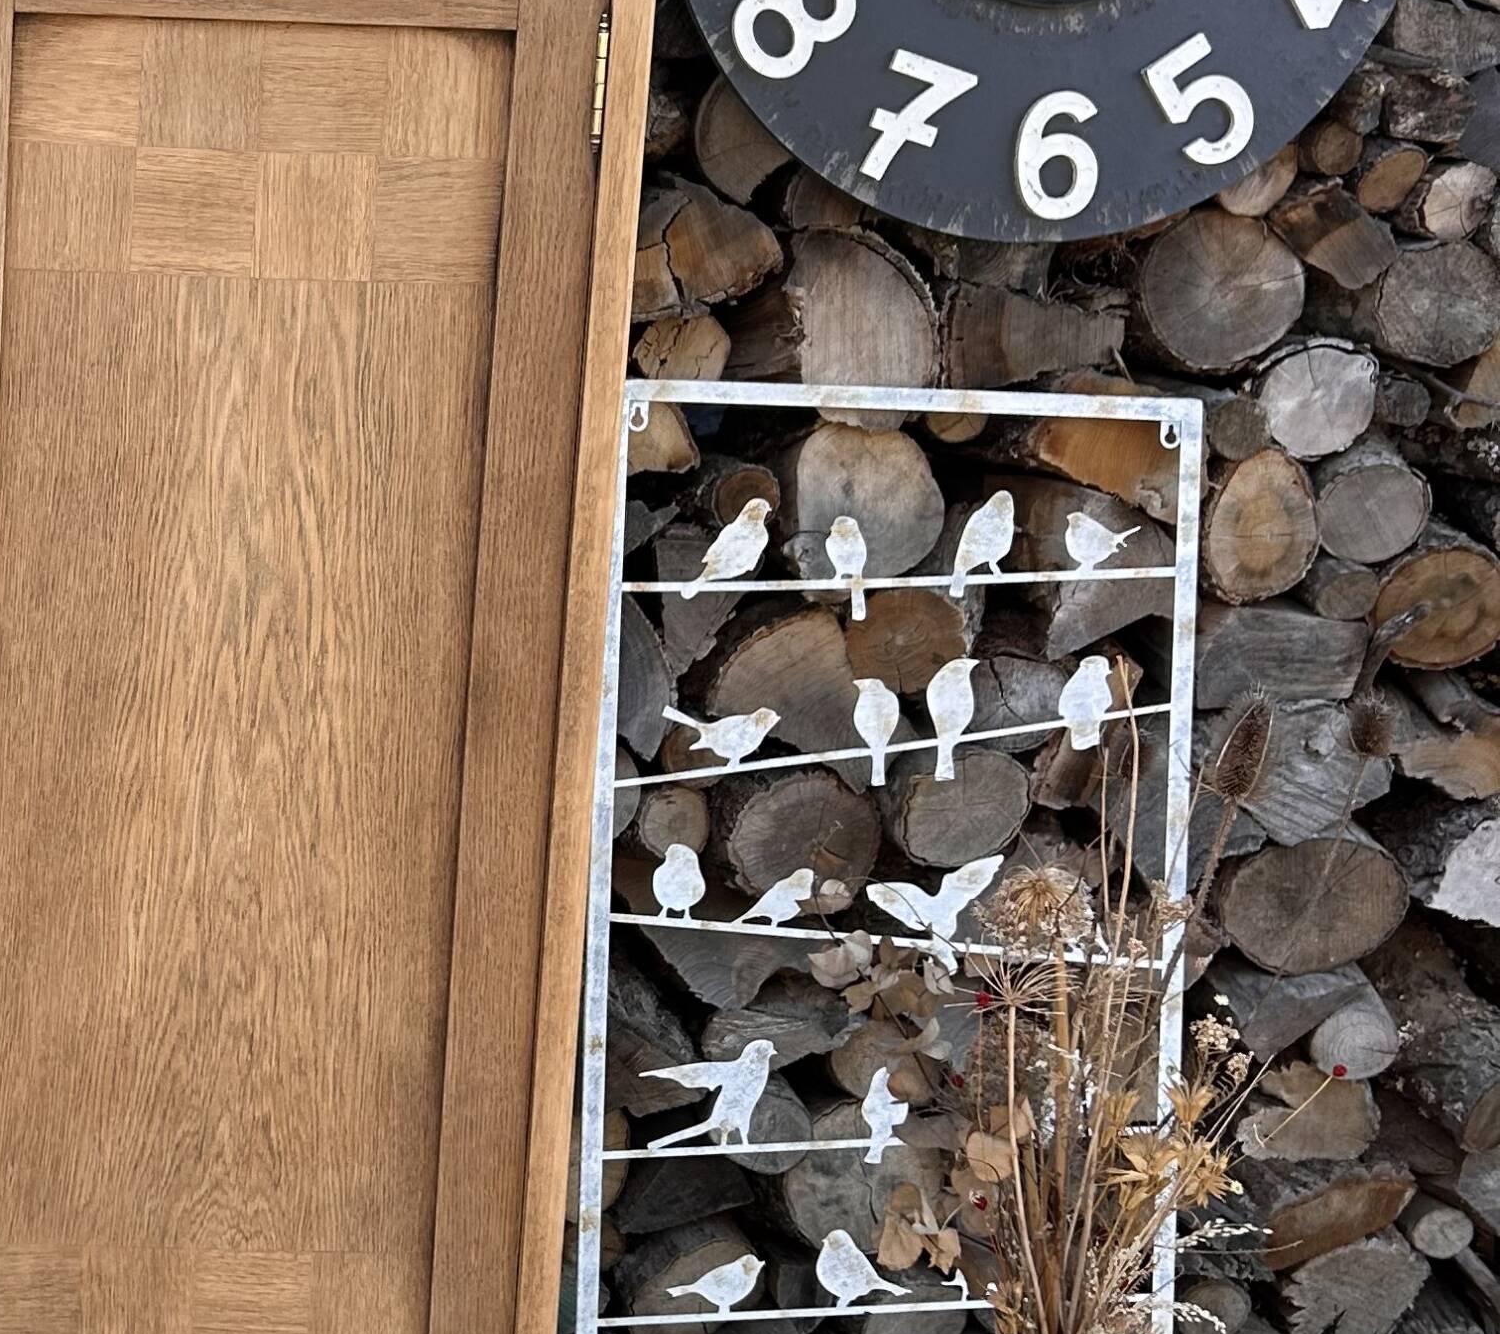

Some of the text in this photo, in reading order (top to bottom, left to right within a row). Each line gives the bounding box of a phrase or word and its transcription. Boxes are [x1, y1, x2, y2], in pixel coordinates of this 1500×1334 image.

[859, 48, 979, 182] 7
[1014, 90, 1099, 221] 6
[1142, 32, 1255, 165] 5
